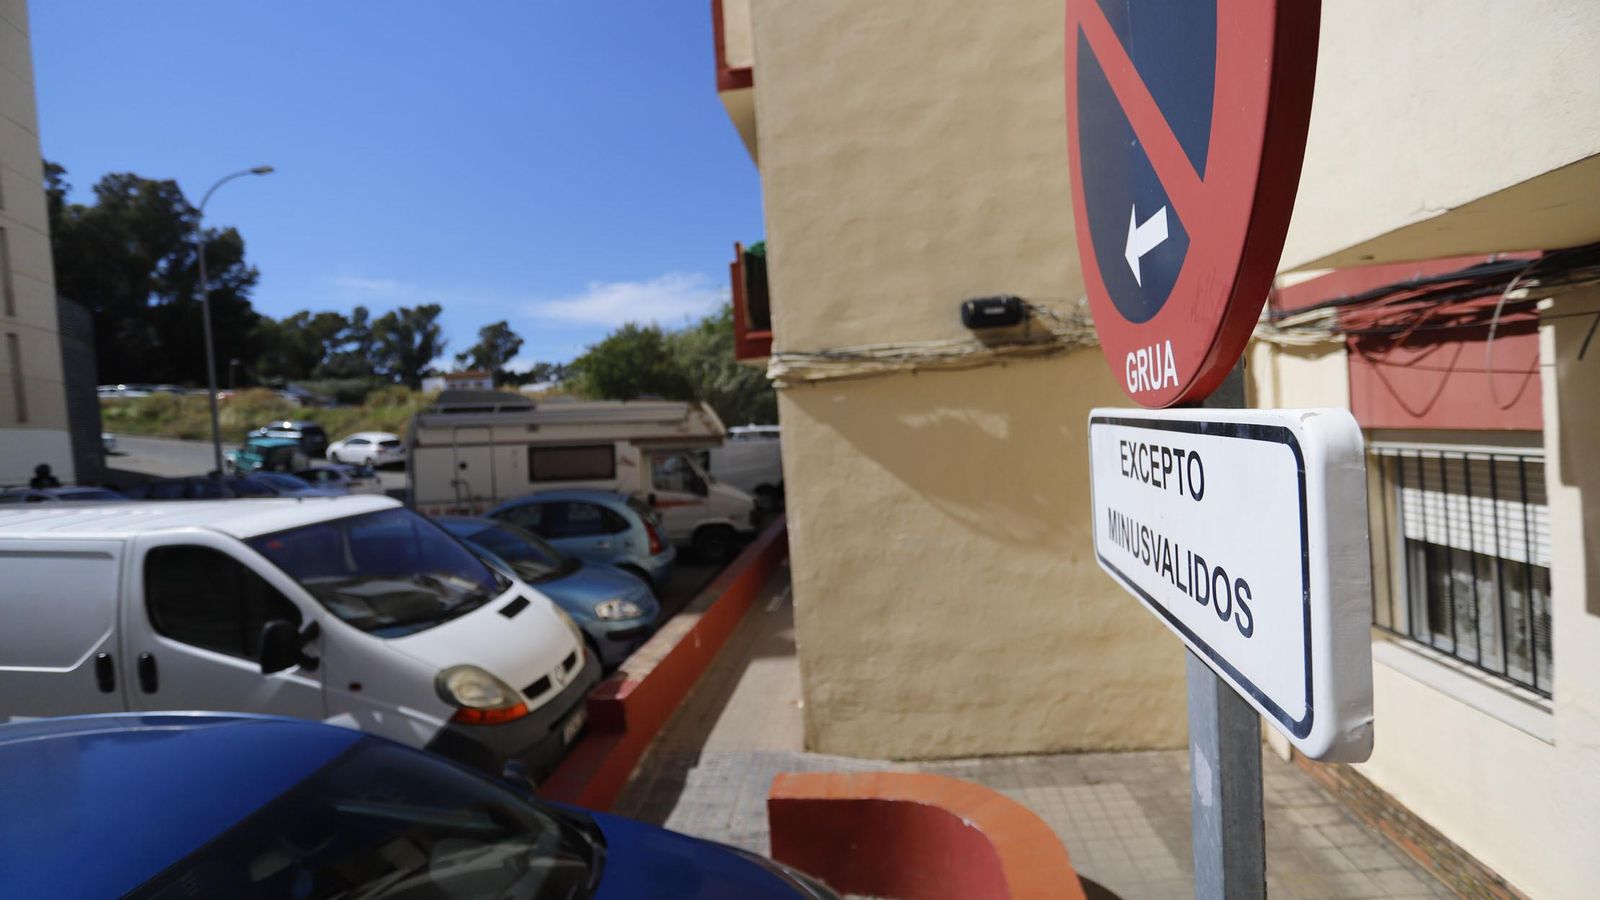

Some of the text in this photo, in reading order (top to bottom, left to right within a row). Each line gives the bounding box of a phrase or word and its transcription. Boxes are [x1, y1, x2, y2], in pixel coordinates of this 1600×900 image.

[1126, 340, 1179, 393] GRUA
[1120, 440, 1205, 501] EXCEPTO
[1108, 507, 1254, 639] MINUSVALIDOS
